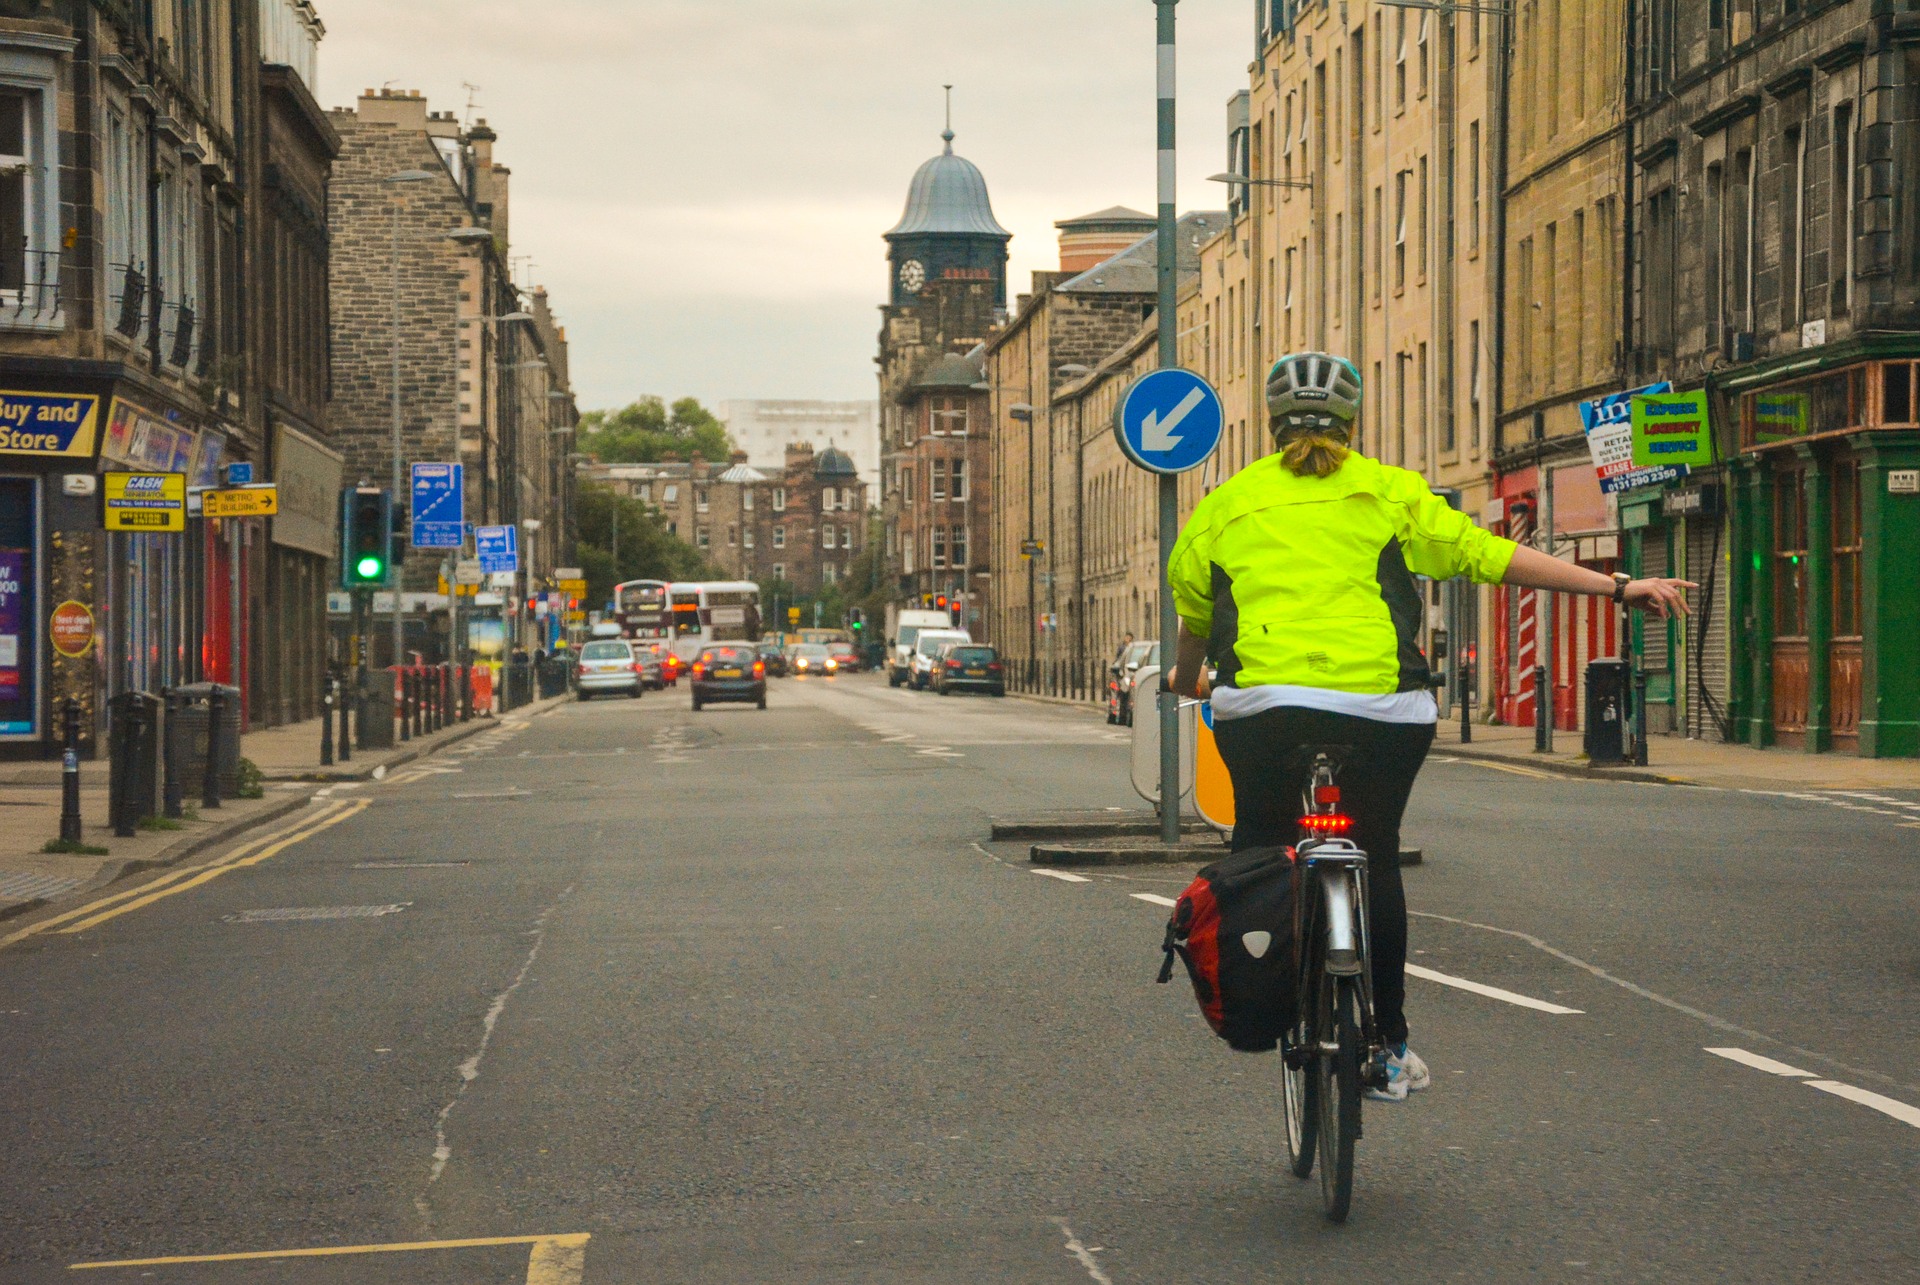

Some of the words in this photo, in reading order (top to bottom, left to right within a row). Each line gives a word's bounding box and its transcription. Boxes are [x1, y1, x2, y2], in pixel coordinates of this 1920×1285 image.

[37, 401, 80, 423] and
[1645, 402, 1698, 416] EXPRESS
[1643, 420, 1701, 435] LAUNDRY
[0, 426, 58, 450] Store
[1648, 440, 1698, 454] SERVICE
[1603, 461, 1629, 475] LEASE
[1613, 473, 1625, 481] ALL
[1626, 465, 1664, 479] ENQUIRIES
[126, 477, 164, 488] CASH
[1608, 479, 1629, 491] 0131
[1631, 475, 1649, 486] 290
[1651, 468, 1677, 482] 2350
[224, 493, 253, 501] METRO
[221, 503, 258, 512] BUILDING
